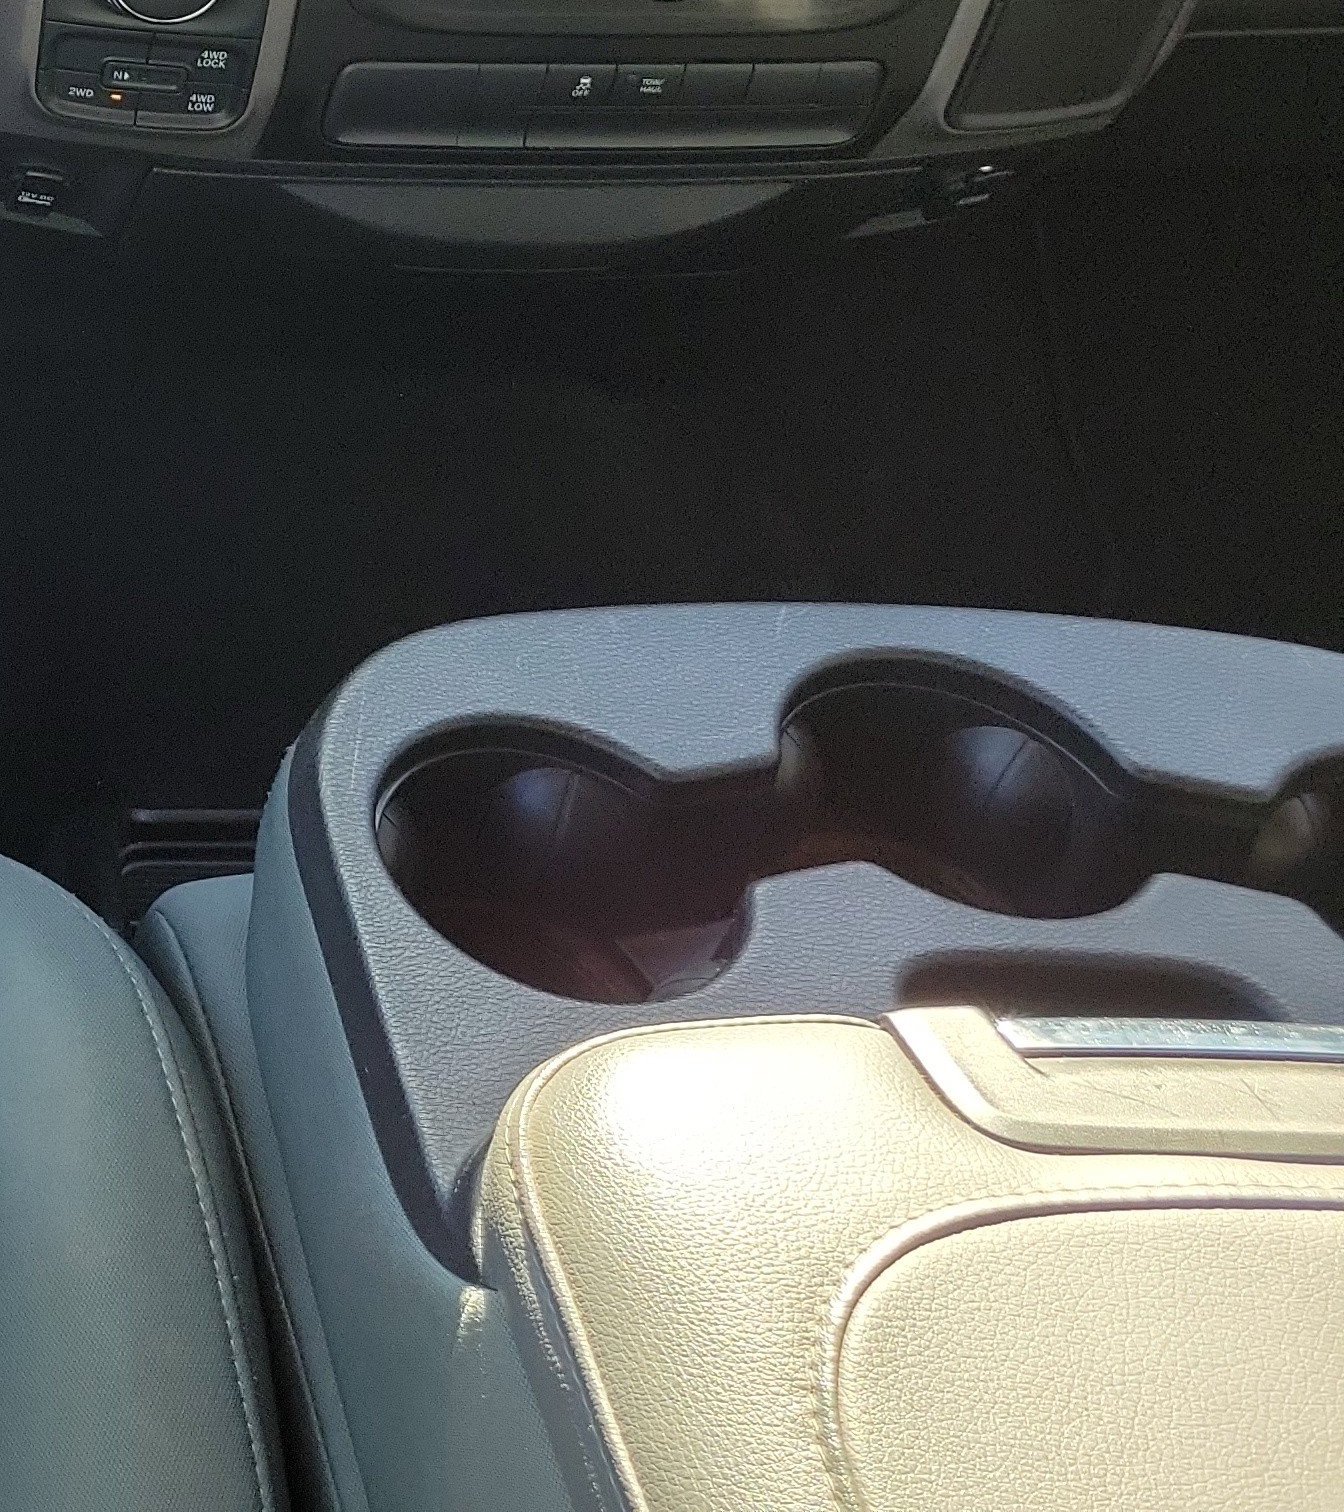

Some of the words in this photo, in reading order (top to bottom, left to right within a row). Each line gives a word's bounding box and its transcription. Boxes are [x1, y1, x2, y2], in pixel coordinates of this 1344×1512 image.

[201, 50, 228, 60] 4WD
[197, 59, 227, 69] LOCK
[68, 87, 94, 98] 2WD
[190, 94, 215, 103] 4WD
[187, 102, 215, 112] LOW
